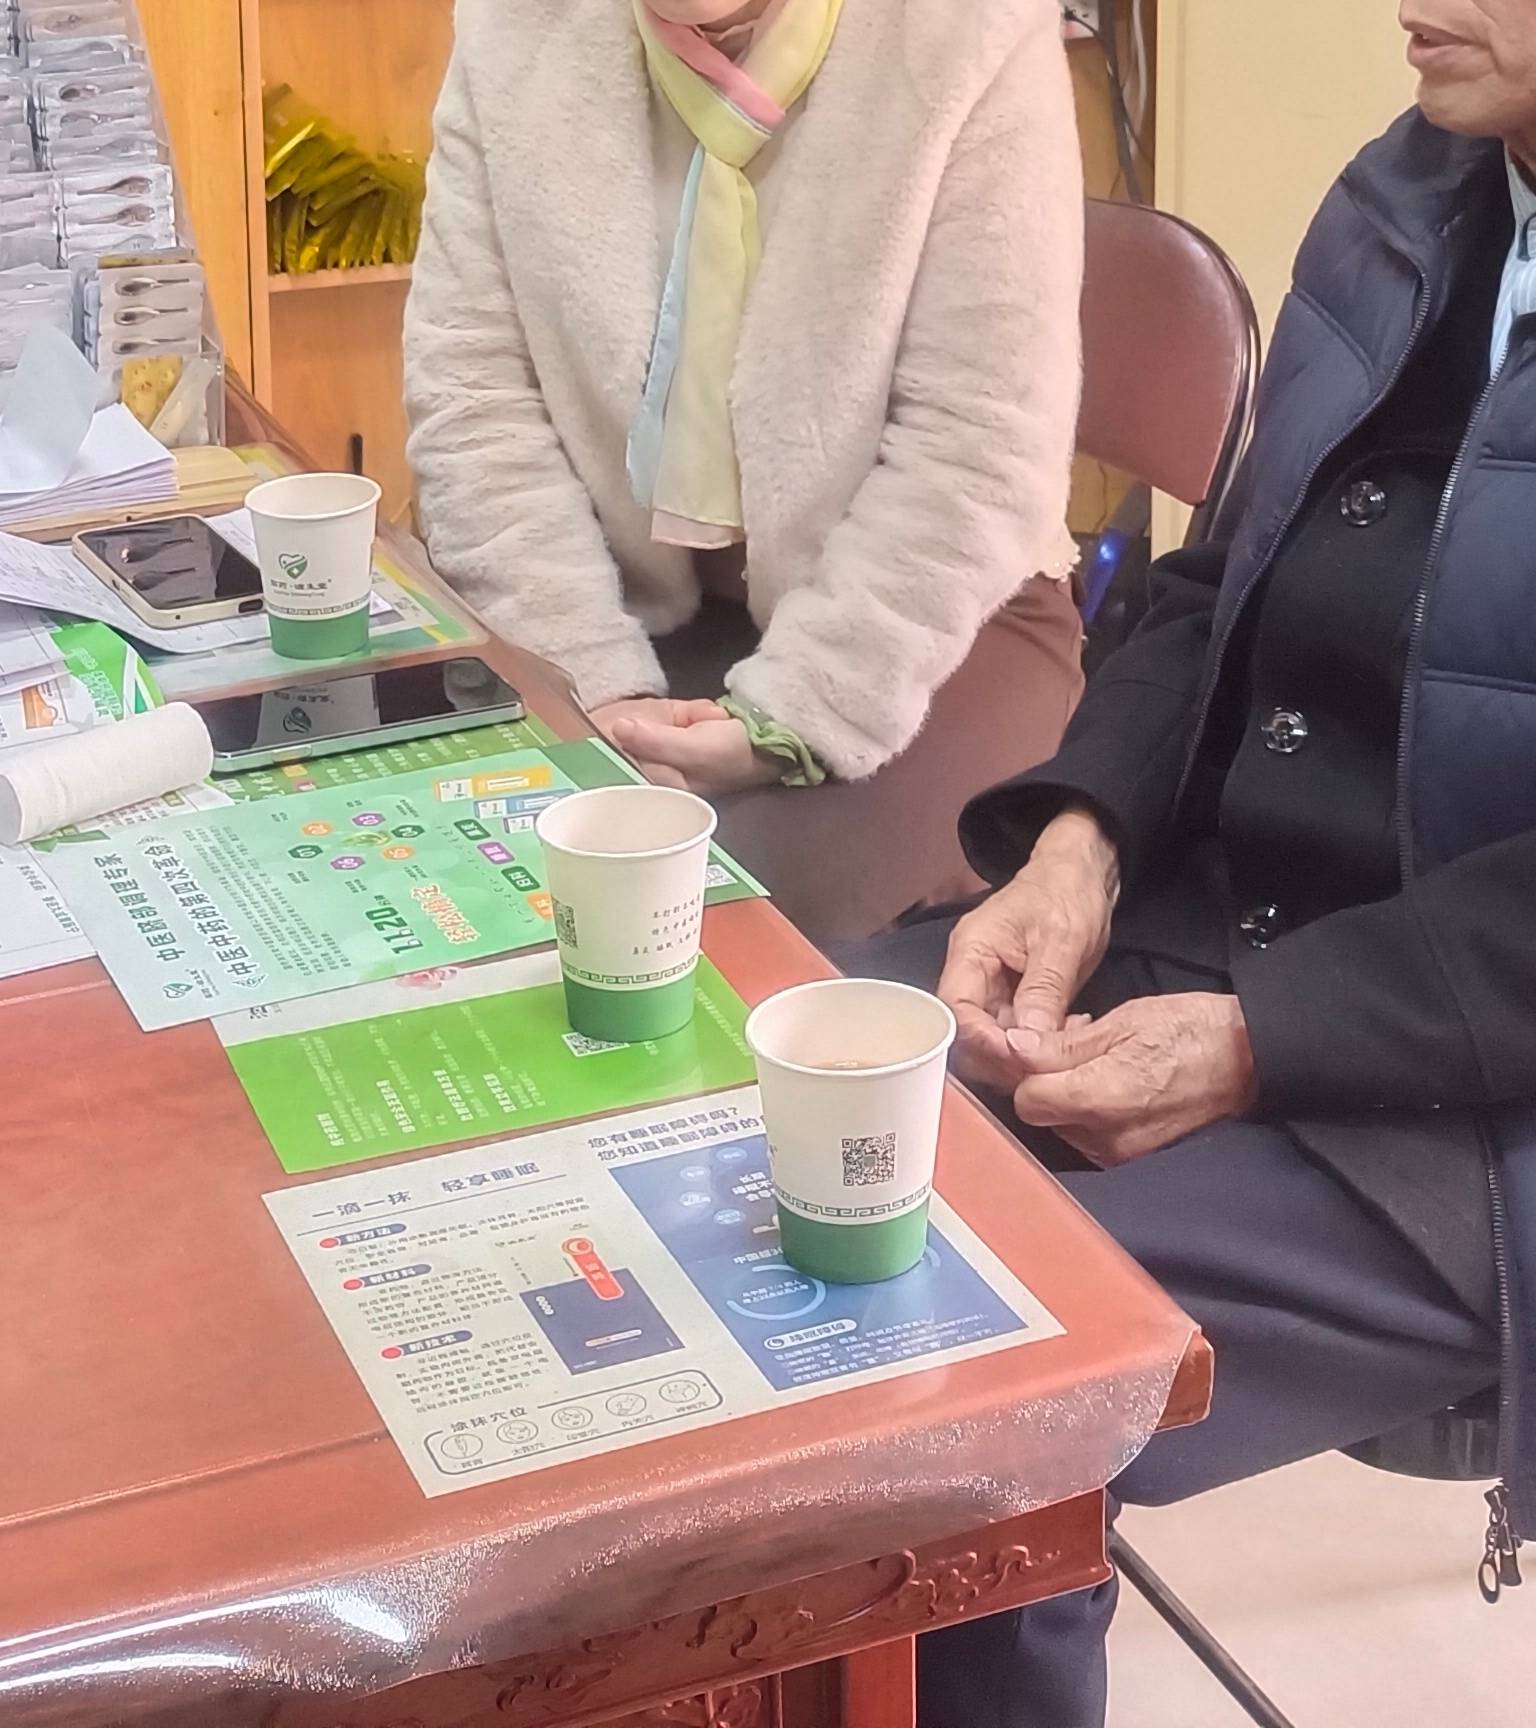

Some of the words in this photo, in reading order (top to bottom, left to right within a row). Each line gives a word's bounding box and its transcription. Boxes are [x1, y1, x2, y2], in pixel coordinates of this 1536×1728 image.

[596, 1114, 766, 1161] 您知道睡眠障碍的
